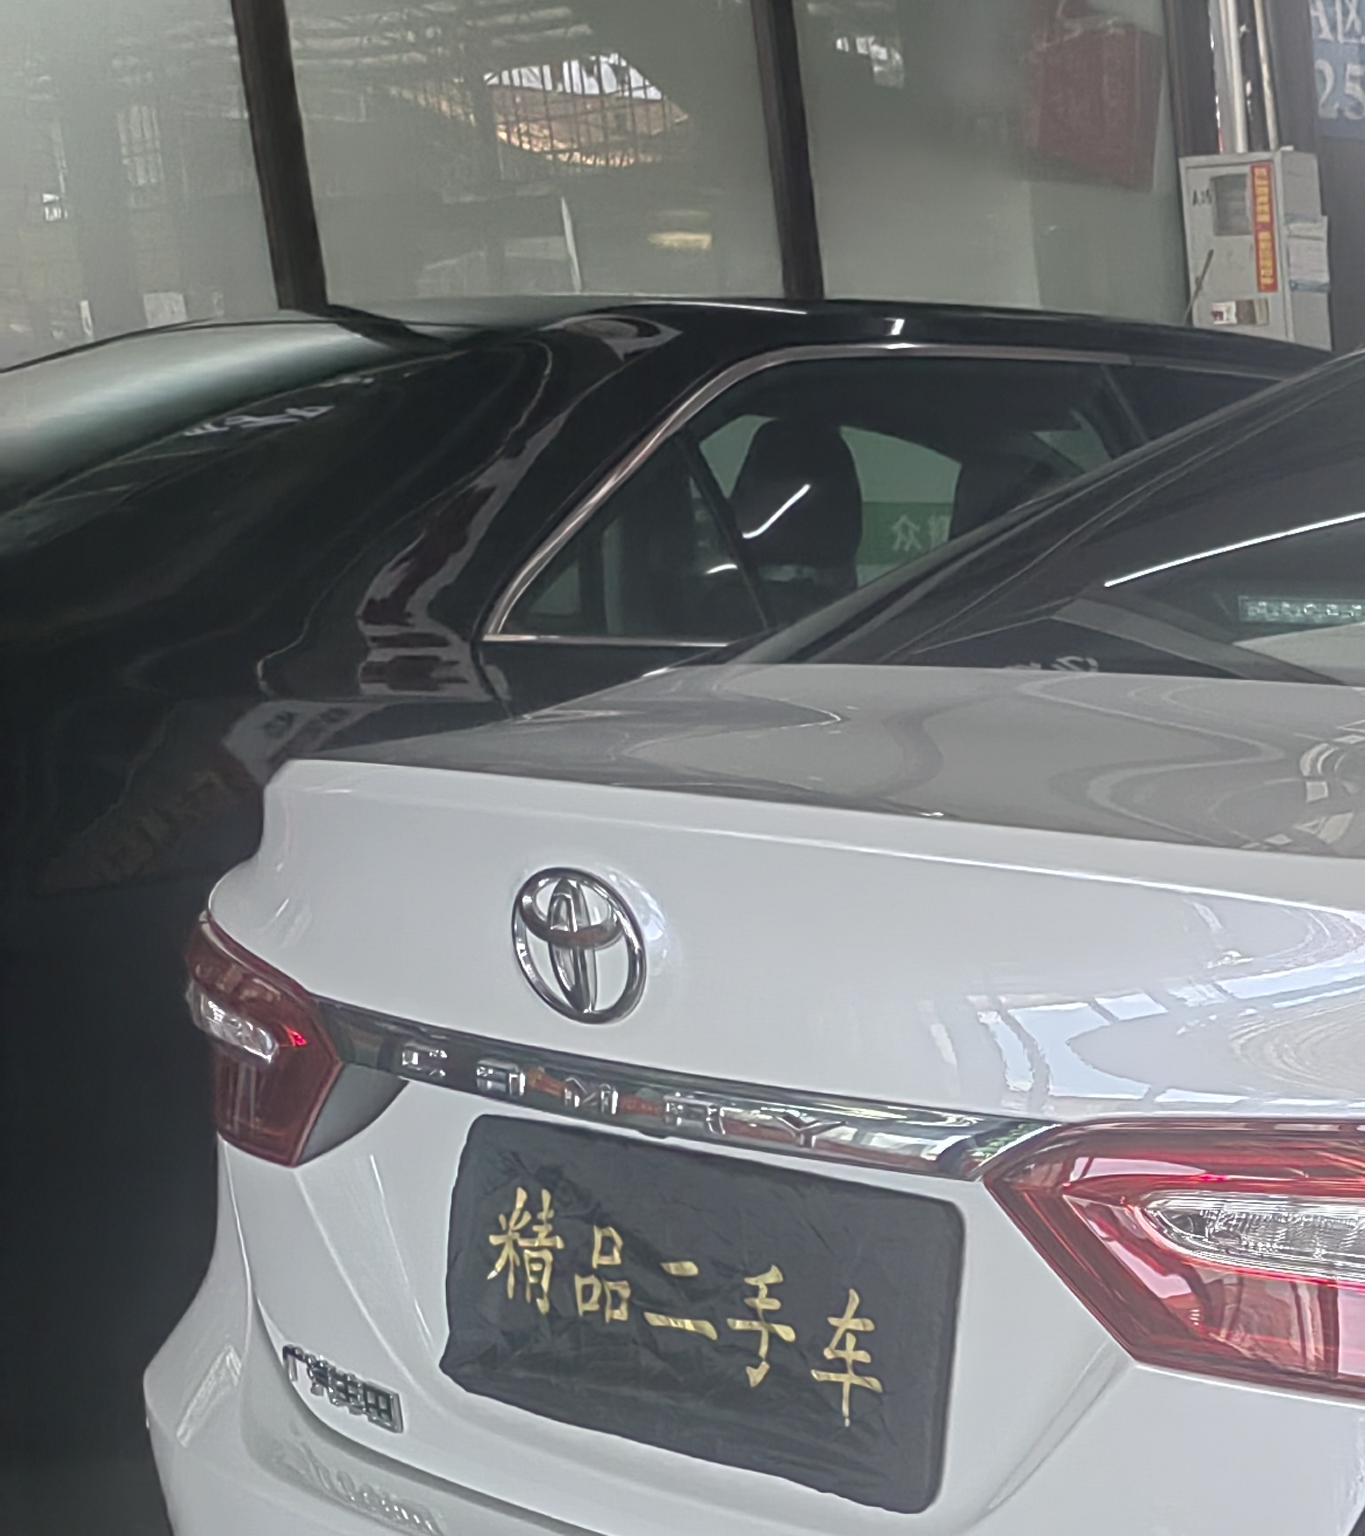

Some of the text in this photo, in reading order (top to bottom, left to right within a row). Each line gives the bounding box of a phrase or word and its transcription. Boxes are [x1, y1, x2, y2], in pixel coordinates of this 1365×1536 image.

[487, 1187, 883, 1427] 精品二手车
